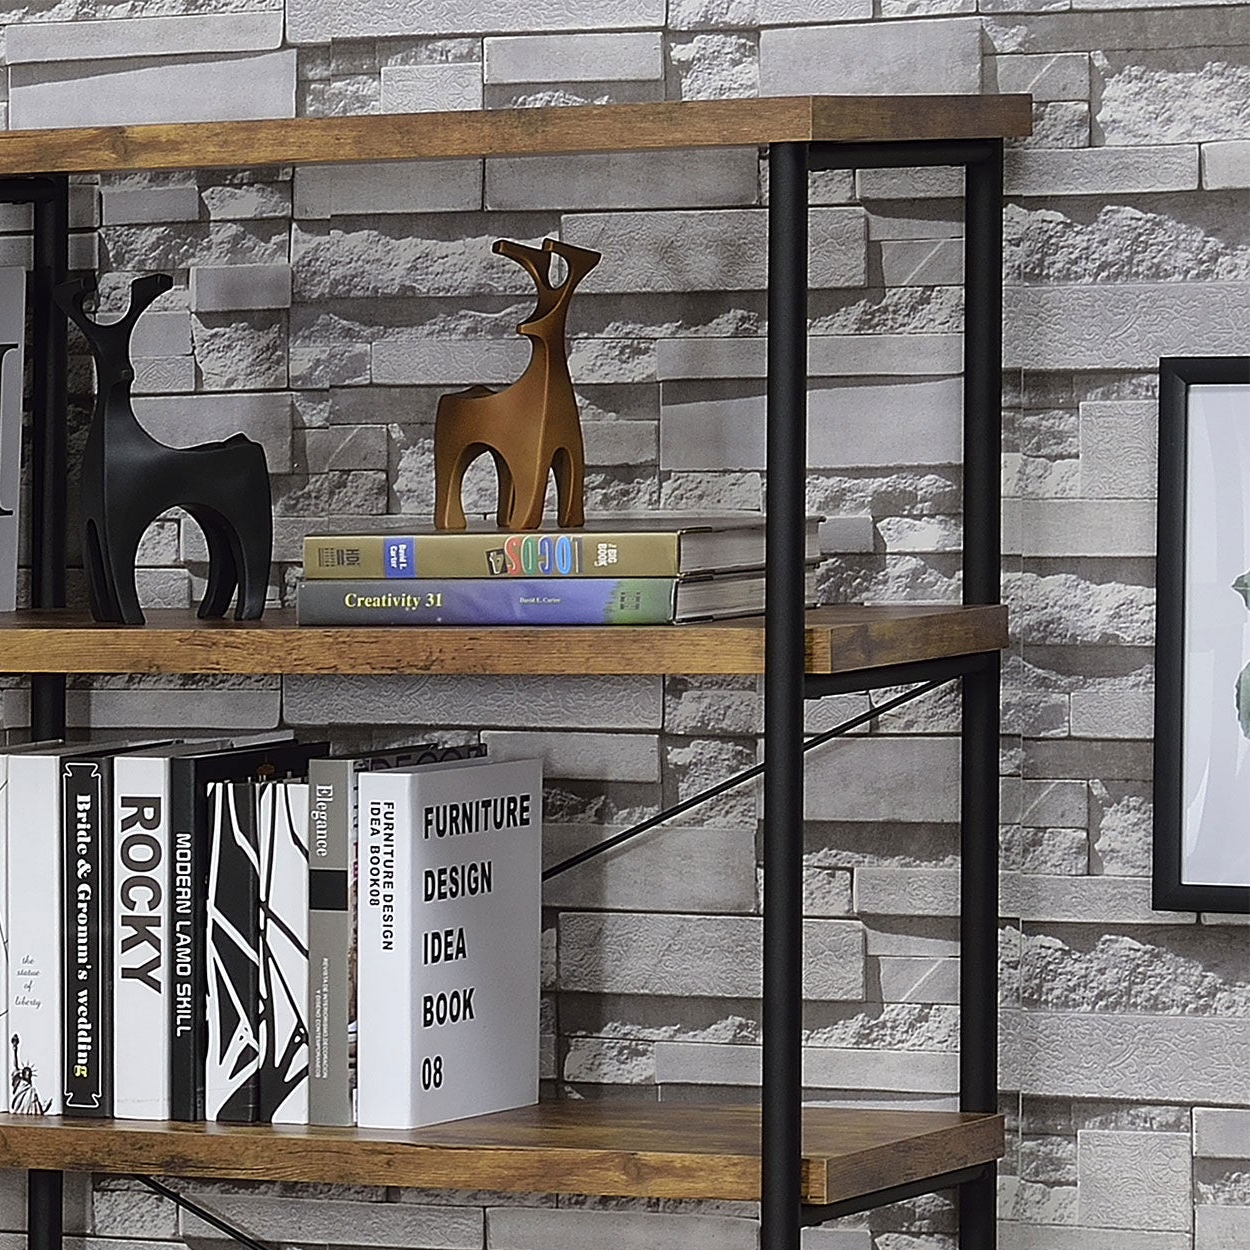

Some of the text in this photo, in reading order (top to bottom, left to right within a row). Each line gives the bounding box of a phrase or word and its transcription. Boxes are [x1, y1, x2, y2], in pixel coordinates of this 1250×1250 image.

[504, 534, 584, 576] LOGOS
[344, 592, 443, 611] Creativity 31
[75, 794, 92, 856] Bride
[311, 784, 334, 857] Elegance
[370, 801, 381, 837] IDEA
[424, 794, 531, 839] FURNITURE
[75, 858, 91, 880] &
[175, 832, 192, 914] MODERN
[382, 801, 395, 950] FURNITURE DESIGN
[424, 861, 493, 902] DESIGN
[120, 795, 162, 994] ROCKY
[423, 928, 467, 965] IDEA
[175, 982, 192, 1037] SKILL
[422, 988, 475, 1027] BOOK
[73, 988, 92, 1078] wedding
[421, 1056, 443, 1090] 08
